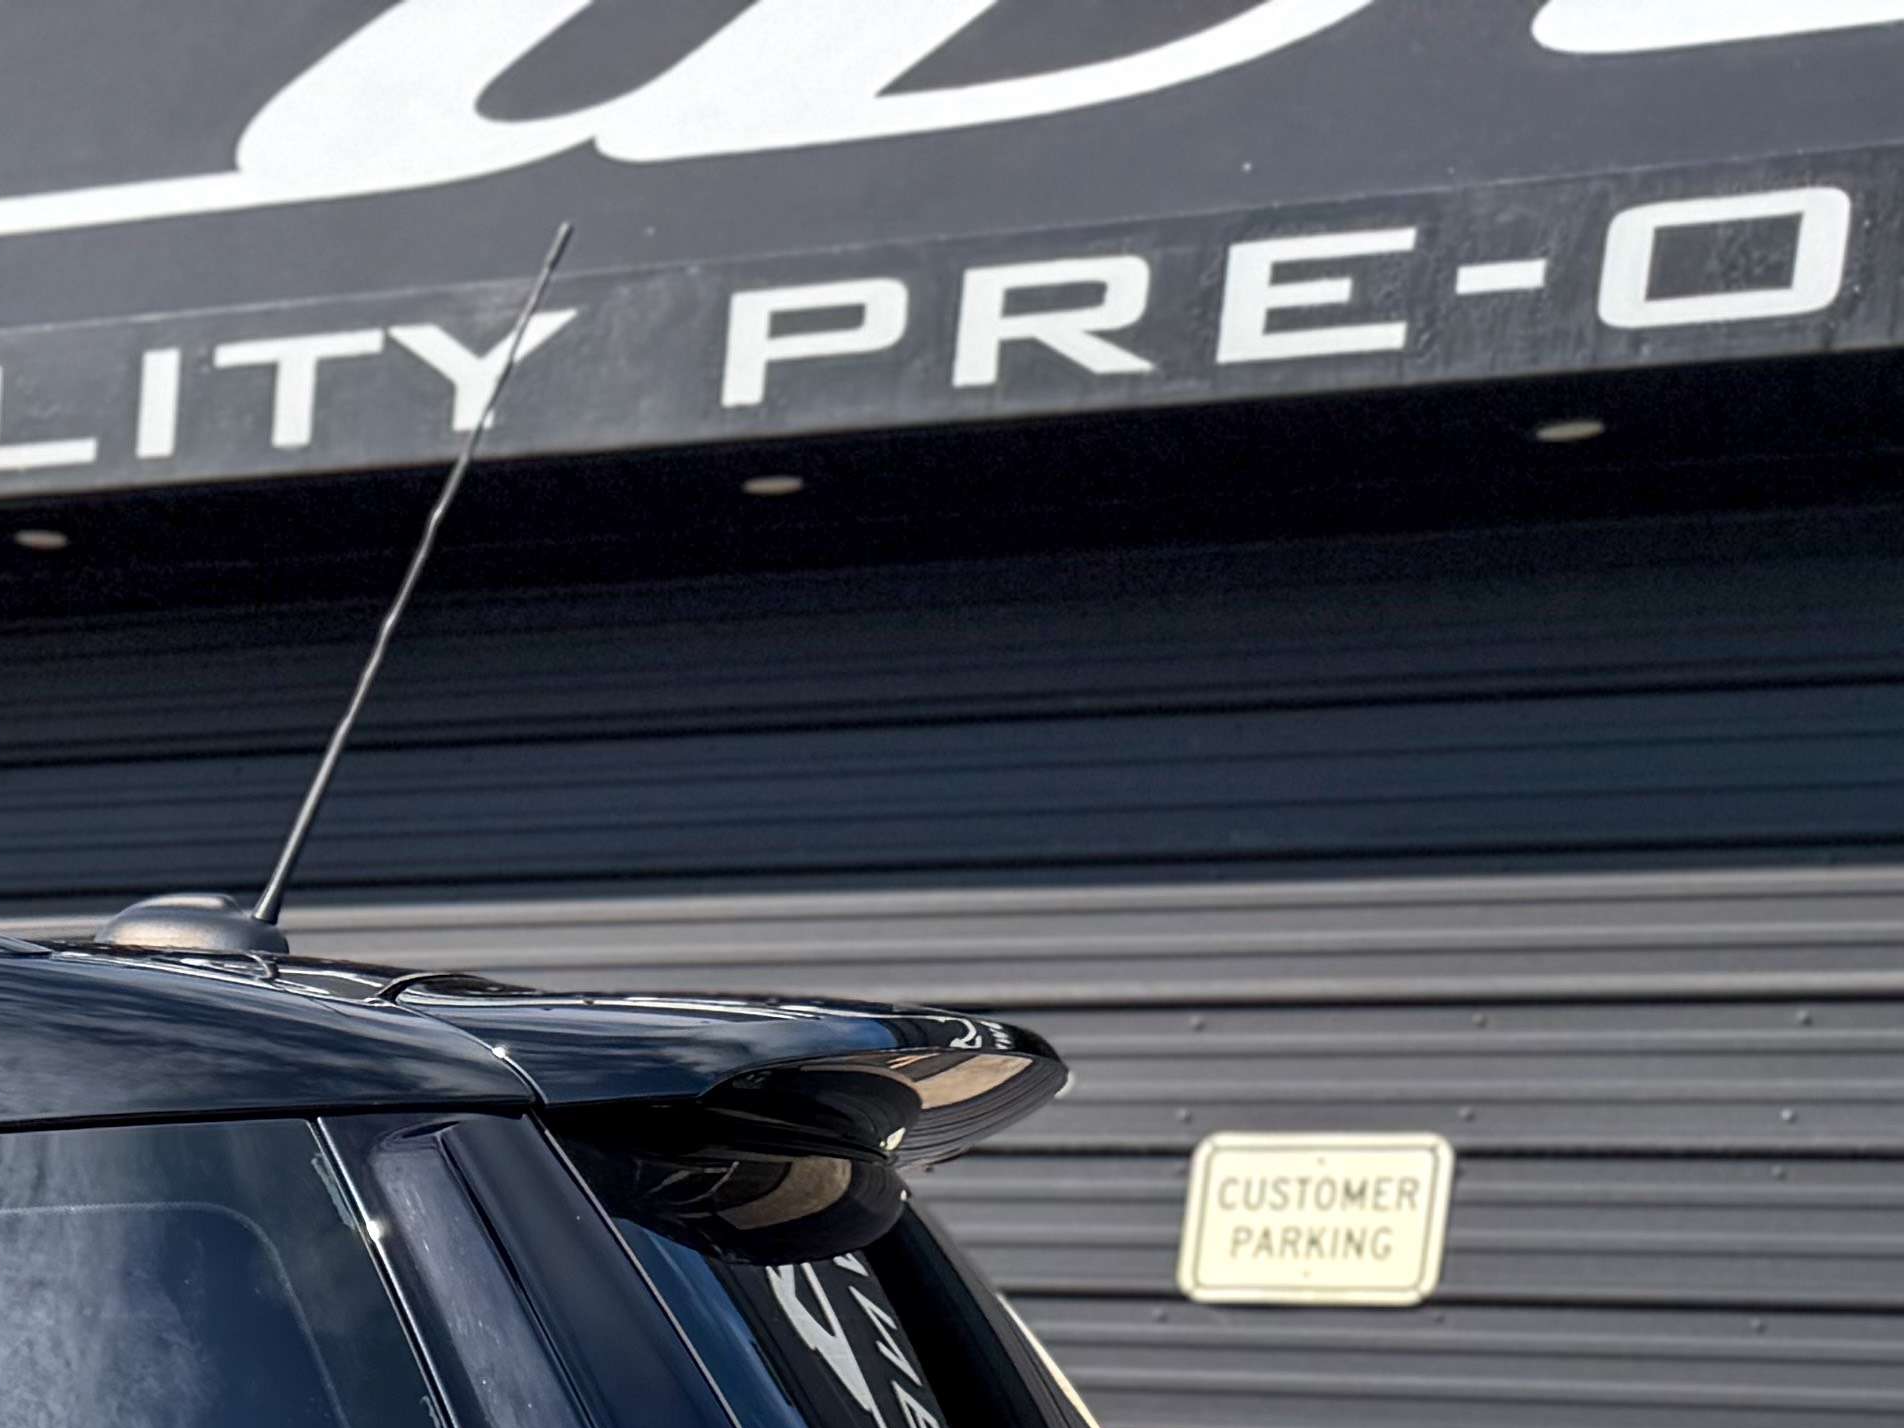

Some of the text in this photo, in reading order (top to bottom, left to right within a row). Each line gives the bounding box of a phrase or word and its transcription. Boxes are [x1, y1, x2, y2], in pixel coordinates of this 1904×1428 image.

[720, 186, 1852, 408] PRE-O
[1217, 1175, 1421, 1213] CUSTOMER
[1228, 1225, 1394, 1261] PARKING
